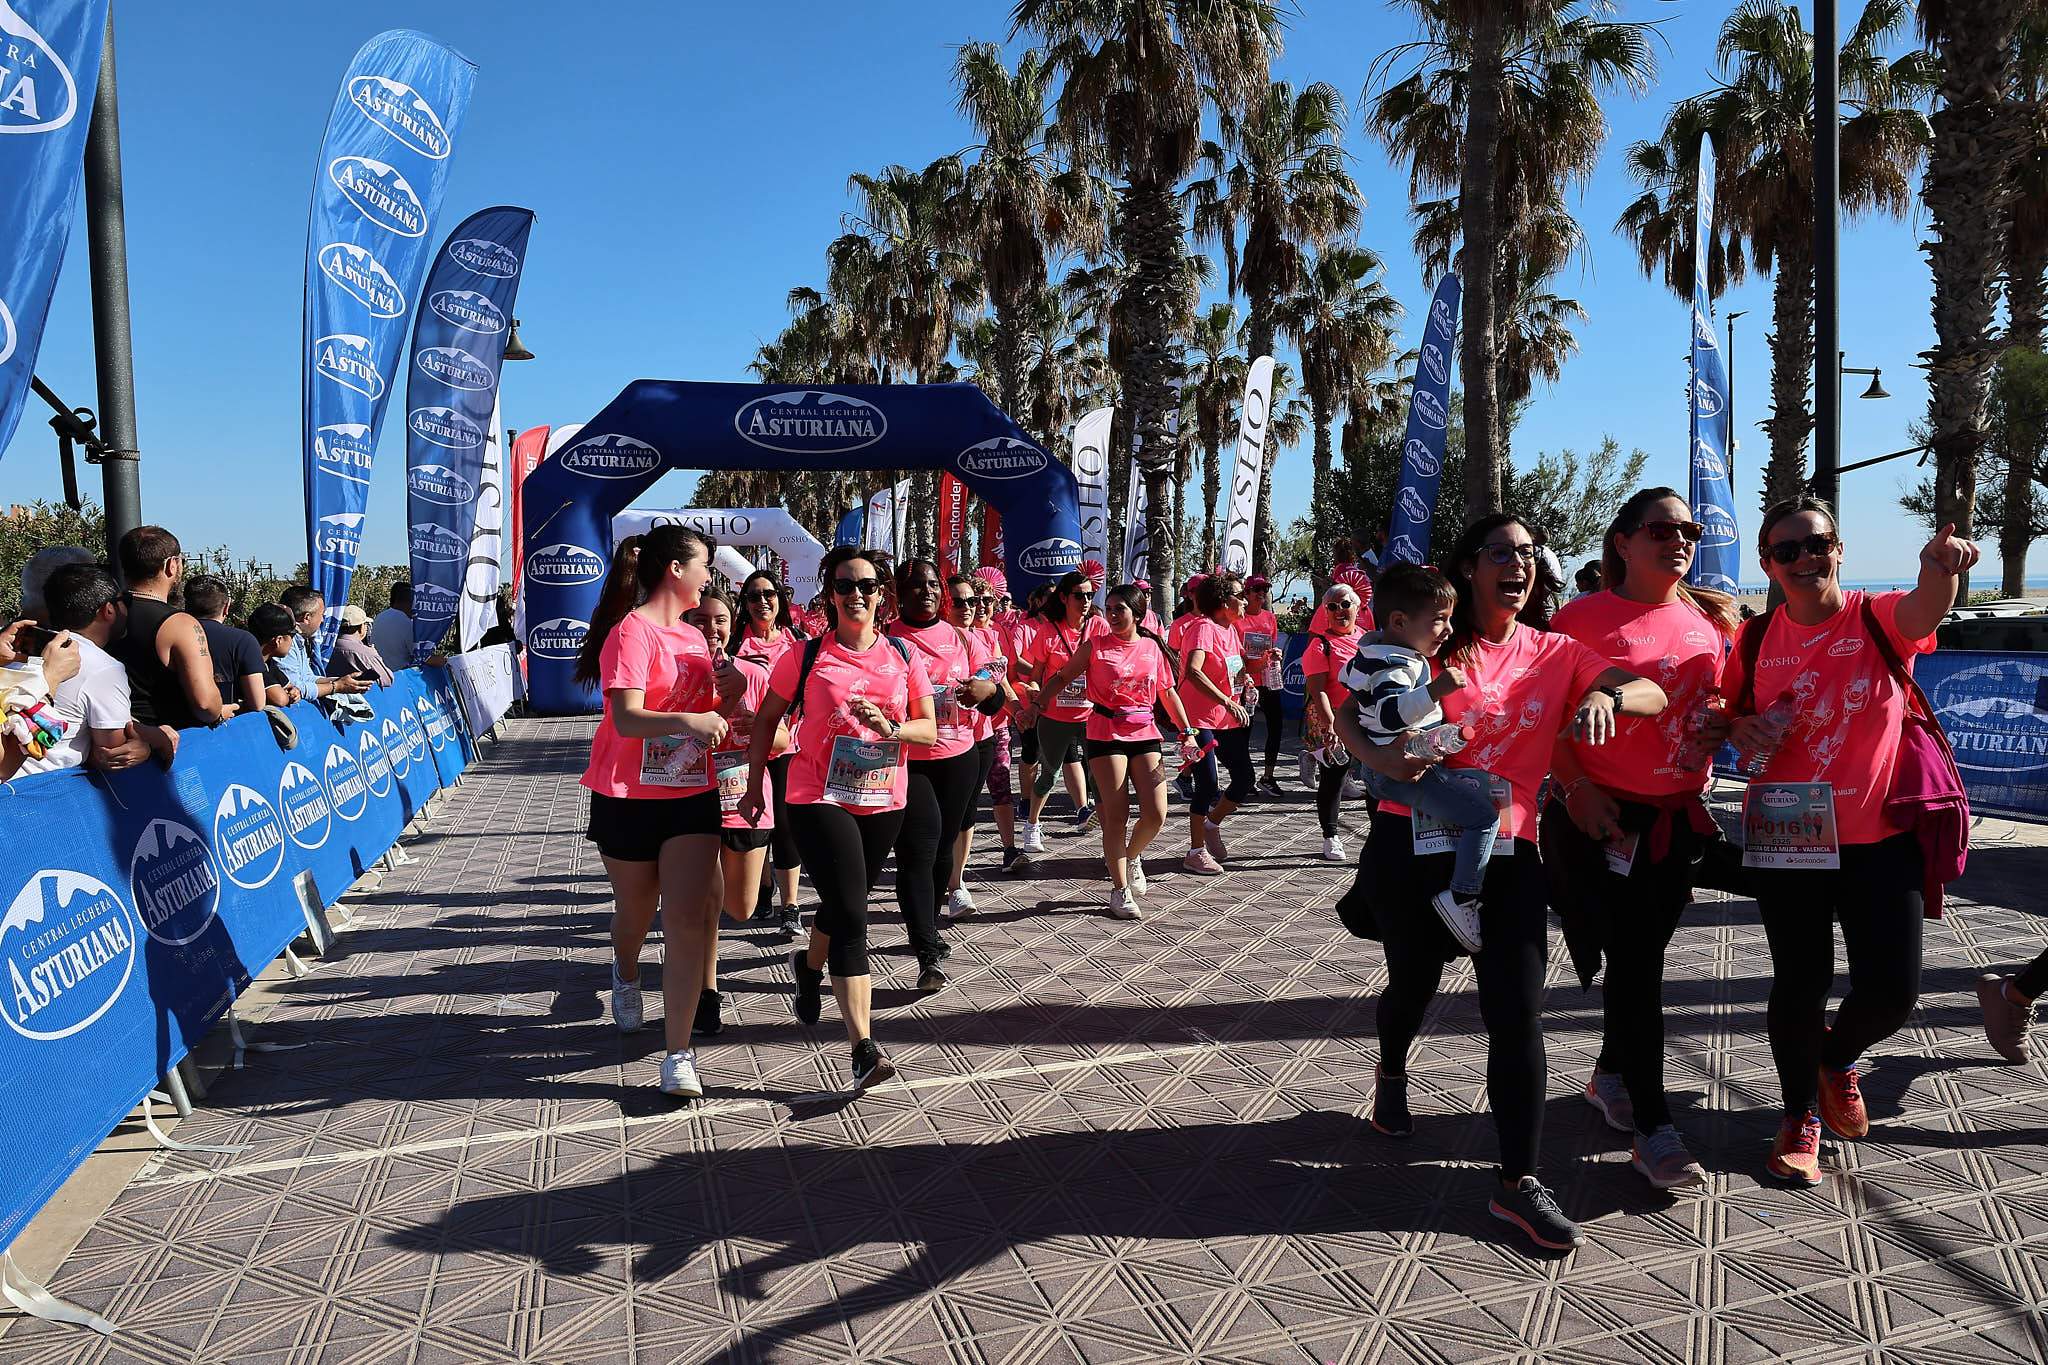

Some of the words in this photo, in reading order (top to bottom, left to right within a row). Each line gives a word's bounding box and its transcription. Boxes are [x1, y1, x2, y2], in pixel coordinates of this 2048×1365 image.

[355, 84, 441, 155] ASTURIANA
[338, 165, 418, 232] ASTURIANA
[454, 244, 513, 274] ASTURIANA
[434, 296, 499, 330] ASTURIANA
[422, 353, 488, 387] ASTURIANA
[747, 408, 877, 437] ASTURIANA
[770, 408, 818, 416] CENTRAL
[414, 414, 476, 445] ASTURIANA
[567, 450, 653, 468] ASTURIANA
[965, 454, 1043, 470] ASTURIANA
[408, 472, 467, 500] ASTURIANA
[1226, 388, 1264, 579] OYSHO
[949, 480, 962, 548] Santander
[779, 535, 809, 544] OYSHO
[531, 559, 599, 575] ASTURIANA
[1617, 635, 1656, 648] OYSHO
[1760, 655, 1801, 668] OYSHO
[1950, 721, 2001, 731] CENTRAL
[329, 774, 365, 807] ASTURIANA
[1764, 796, 1798, 804] ASTURIANA
[227, 817, 249, 837] CENTRAL
[249, 808, 271, 825] LECHERA
[285, 795, 329, 835] ASTURIANA
[221, 821, 282, 875] ASTURIANA
[1420, 829, 1442, 839] CARRERA
[1779, 845, 1798, 853] MUJER
[1794, 856, 1827, 864] Santander
[148, 859, 176, 883] CENTRAL
[140, 861, 217, 930] ASTURIANA
[22, 928, 70, 959] CENTRAL
[70, 897, 112, 930] LECHERA
[8, 916, 130, 1024] ASTURIANA
